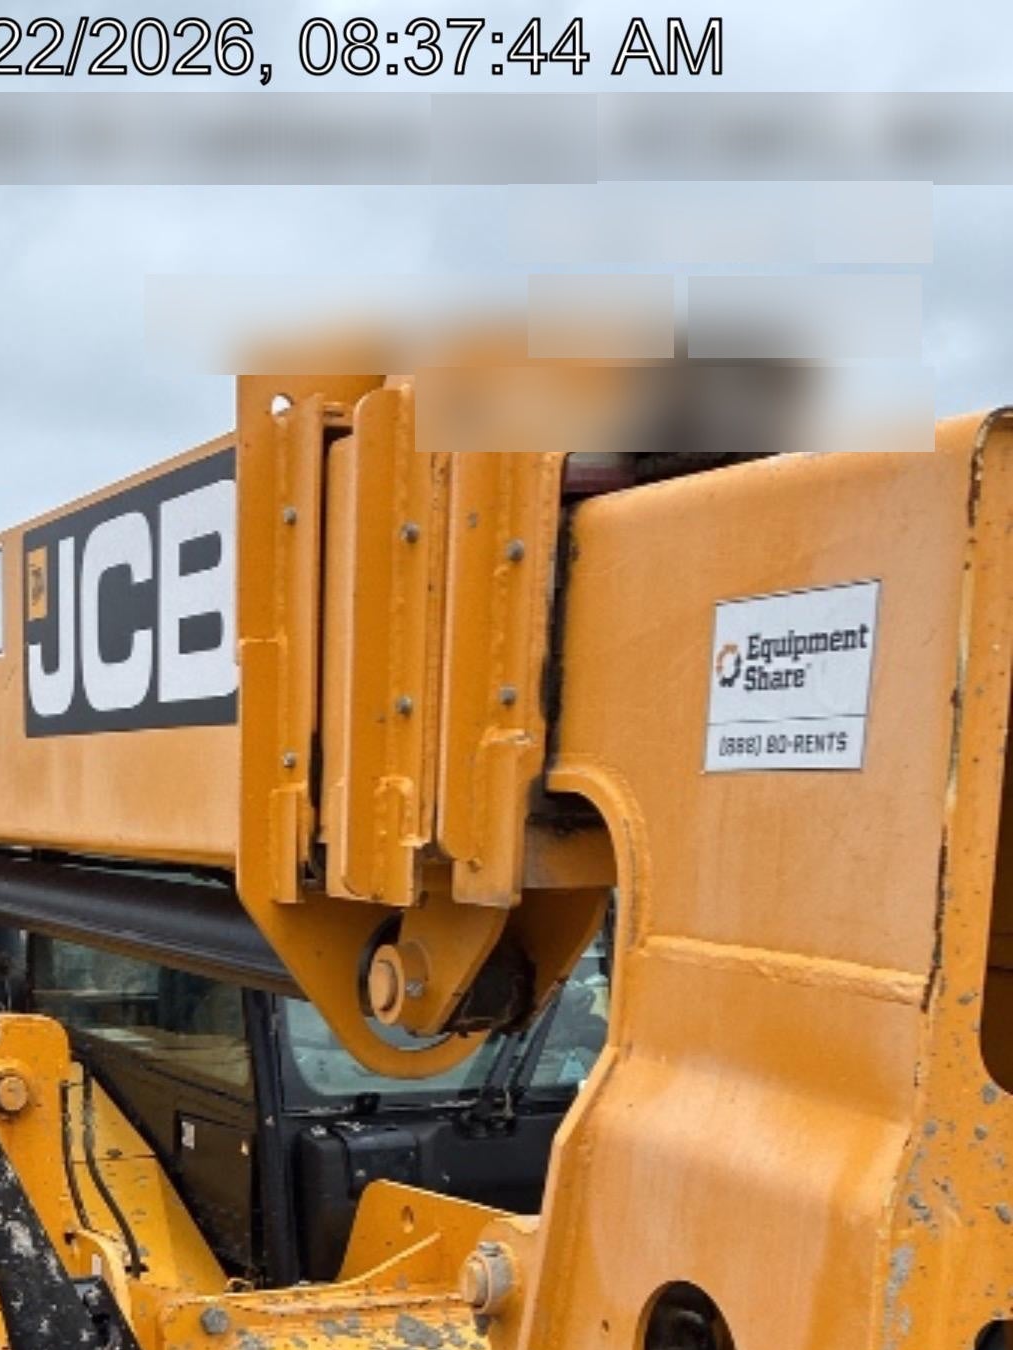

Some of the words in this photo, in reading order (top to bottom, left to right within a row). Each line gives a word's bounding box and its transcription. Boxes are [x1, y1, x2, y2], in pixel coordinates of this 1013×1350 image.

[28, 478, 238, 717] JCB
[746, 623, 869, 664] Equipment
[743, 665, 806, 693] Share
